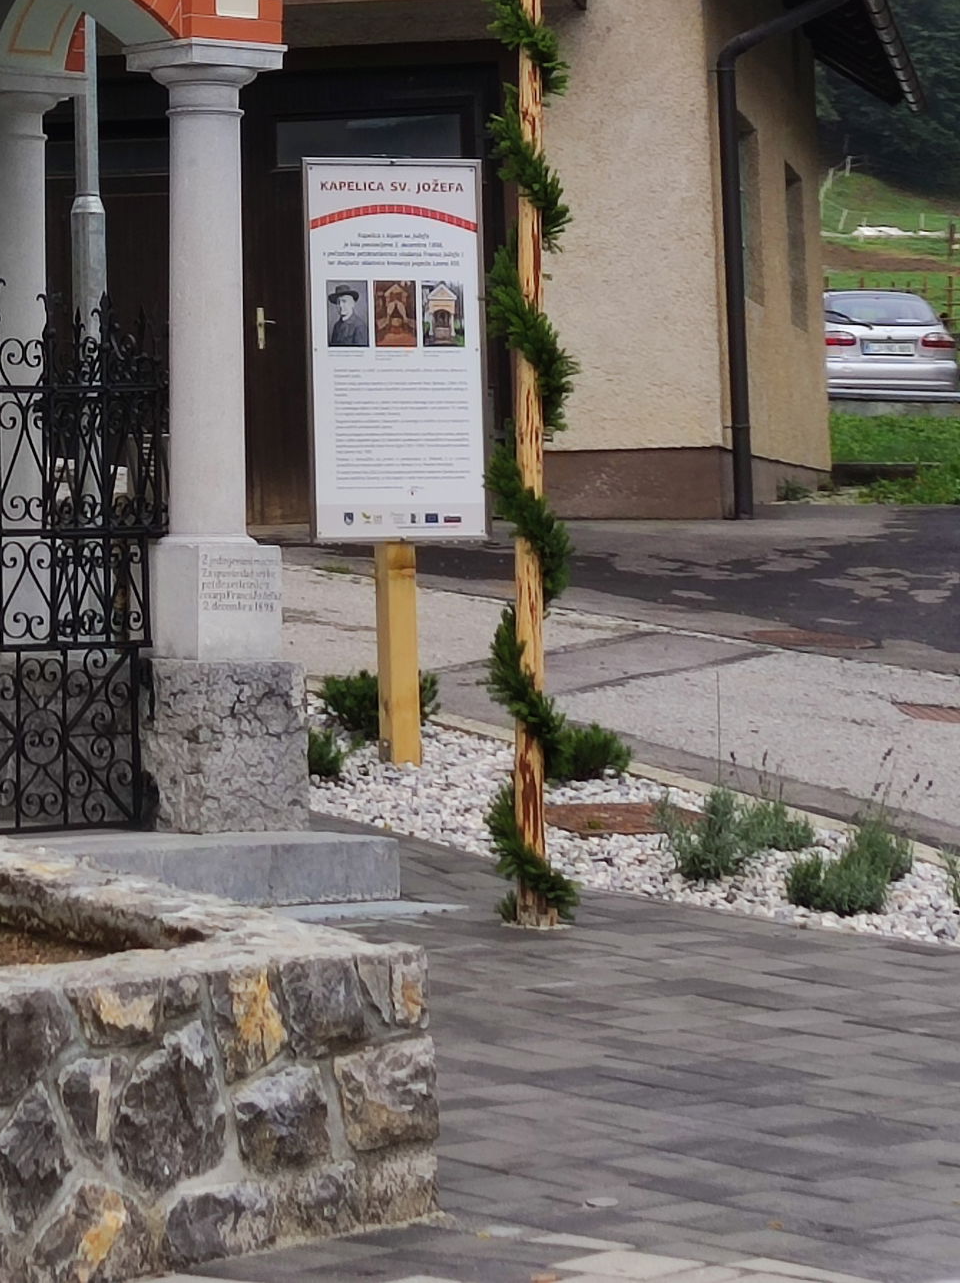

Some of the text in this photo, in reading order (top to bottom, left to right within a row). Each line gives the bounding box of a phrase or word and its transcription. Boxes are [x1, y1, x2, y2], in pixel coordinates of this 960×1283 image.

[320, 178, 464, 195] KAPELICA SV. JOŽEFA
